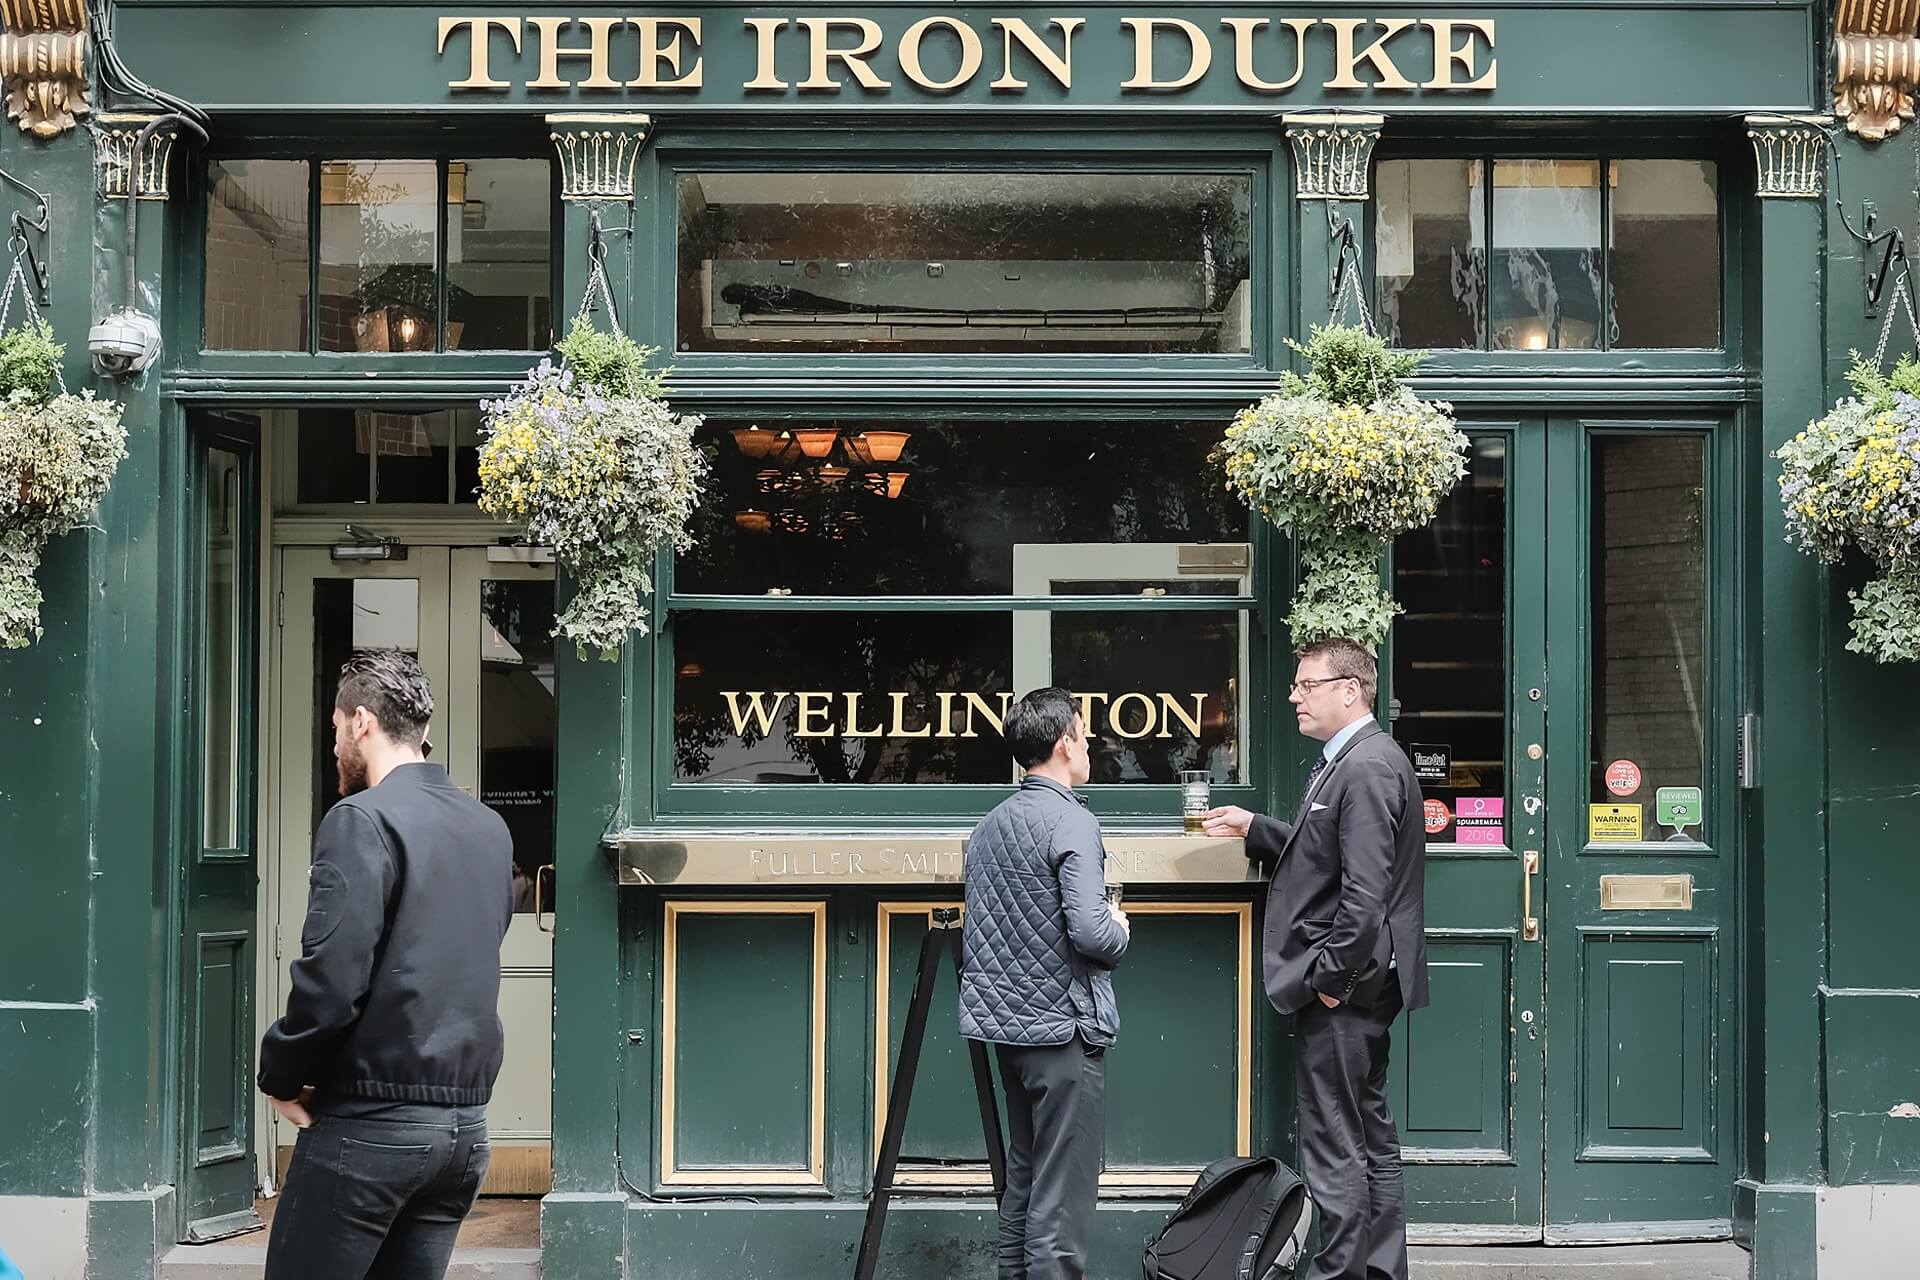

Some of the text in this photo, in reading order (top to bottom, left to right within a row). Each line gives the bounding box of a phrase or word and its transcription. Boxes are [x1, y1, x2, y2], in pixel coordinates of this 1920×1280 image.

[438, 16, 1497, 90] THE IRON DUKE
[720, 691, 1208, 738] WELLINTON
[1456, 818, 1502, 826] SQUAREMEAL
[1594, 815, 1637, 823] WARNING
[1465, 829, 1495, 841] 2016
[751, 849, 864, 875] FULLER
[879, 848, 969, 875] SMIT
